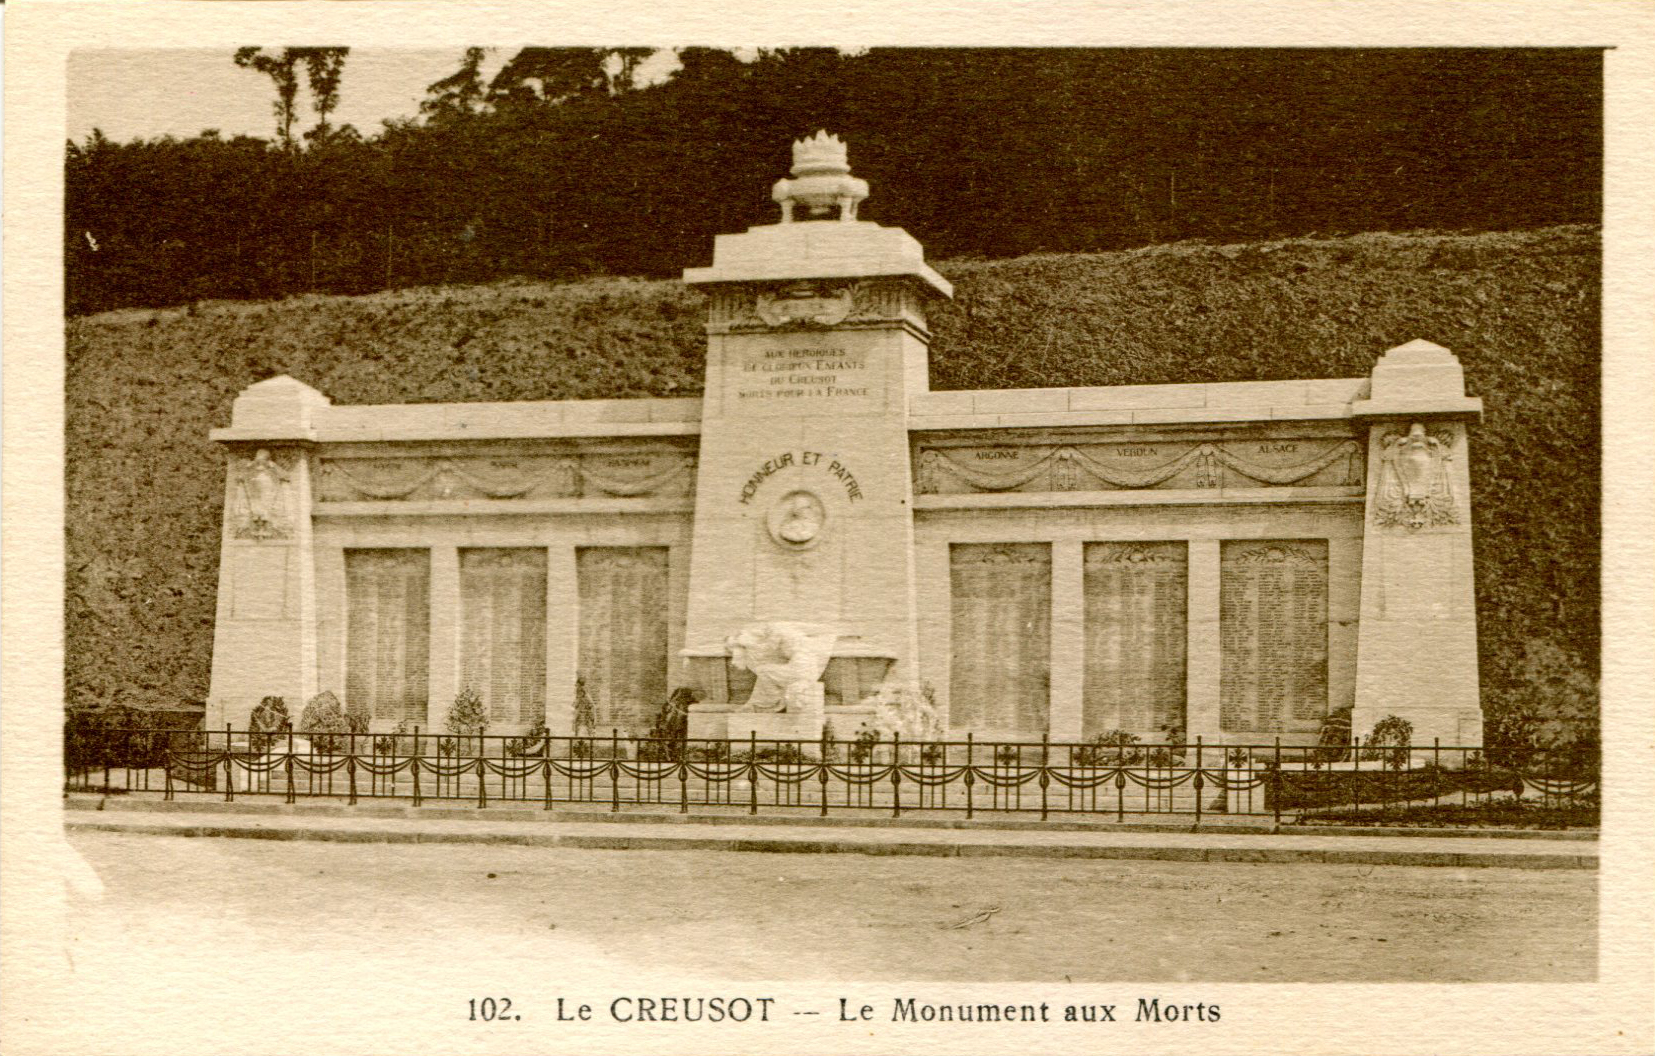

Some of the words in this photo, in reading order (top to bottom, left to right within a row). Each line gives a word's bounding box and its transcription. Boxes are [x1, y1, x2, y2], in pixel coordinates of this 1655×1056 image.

[764, 349, 785, 359] AUX
[1116, 447, 1159, 457] VERDUN
[1258, 444, 1299, 454] ALSACE
[975, 451, 1020, 460] ARGONNE
[739, 452, 794, 505] HONNEUR
[802, 451, 823, 466] ET
[828, 460, 863, 504] PATRIE
